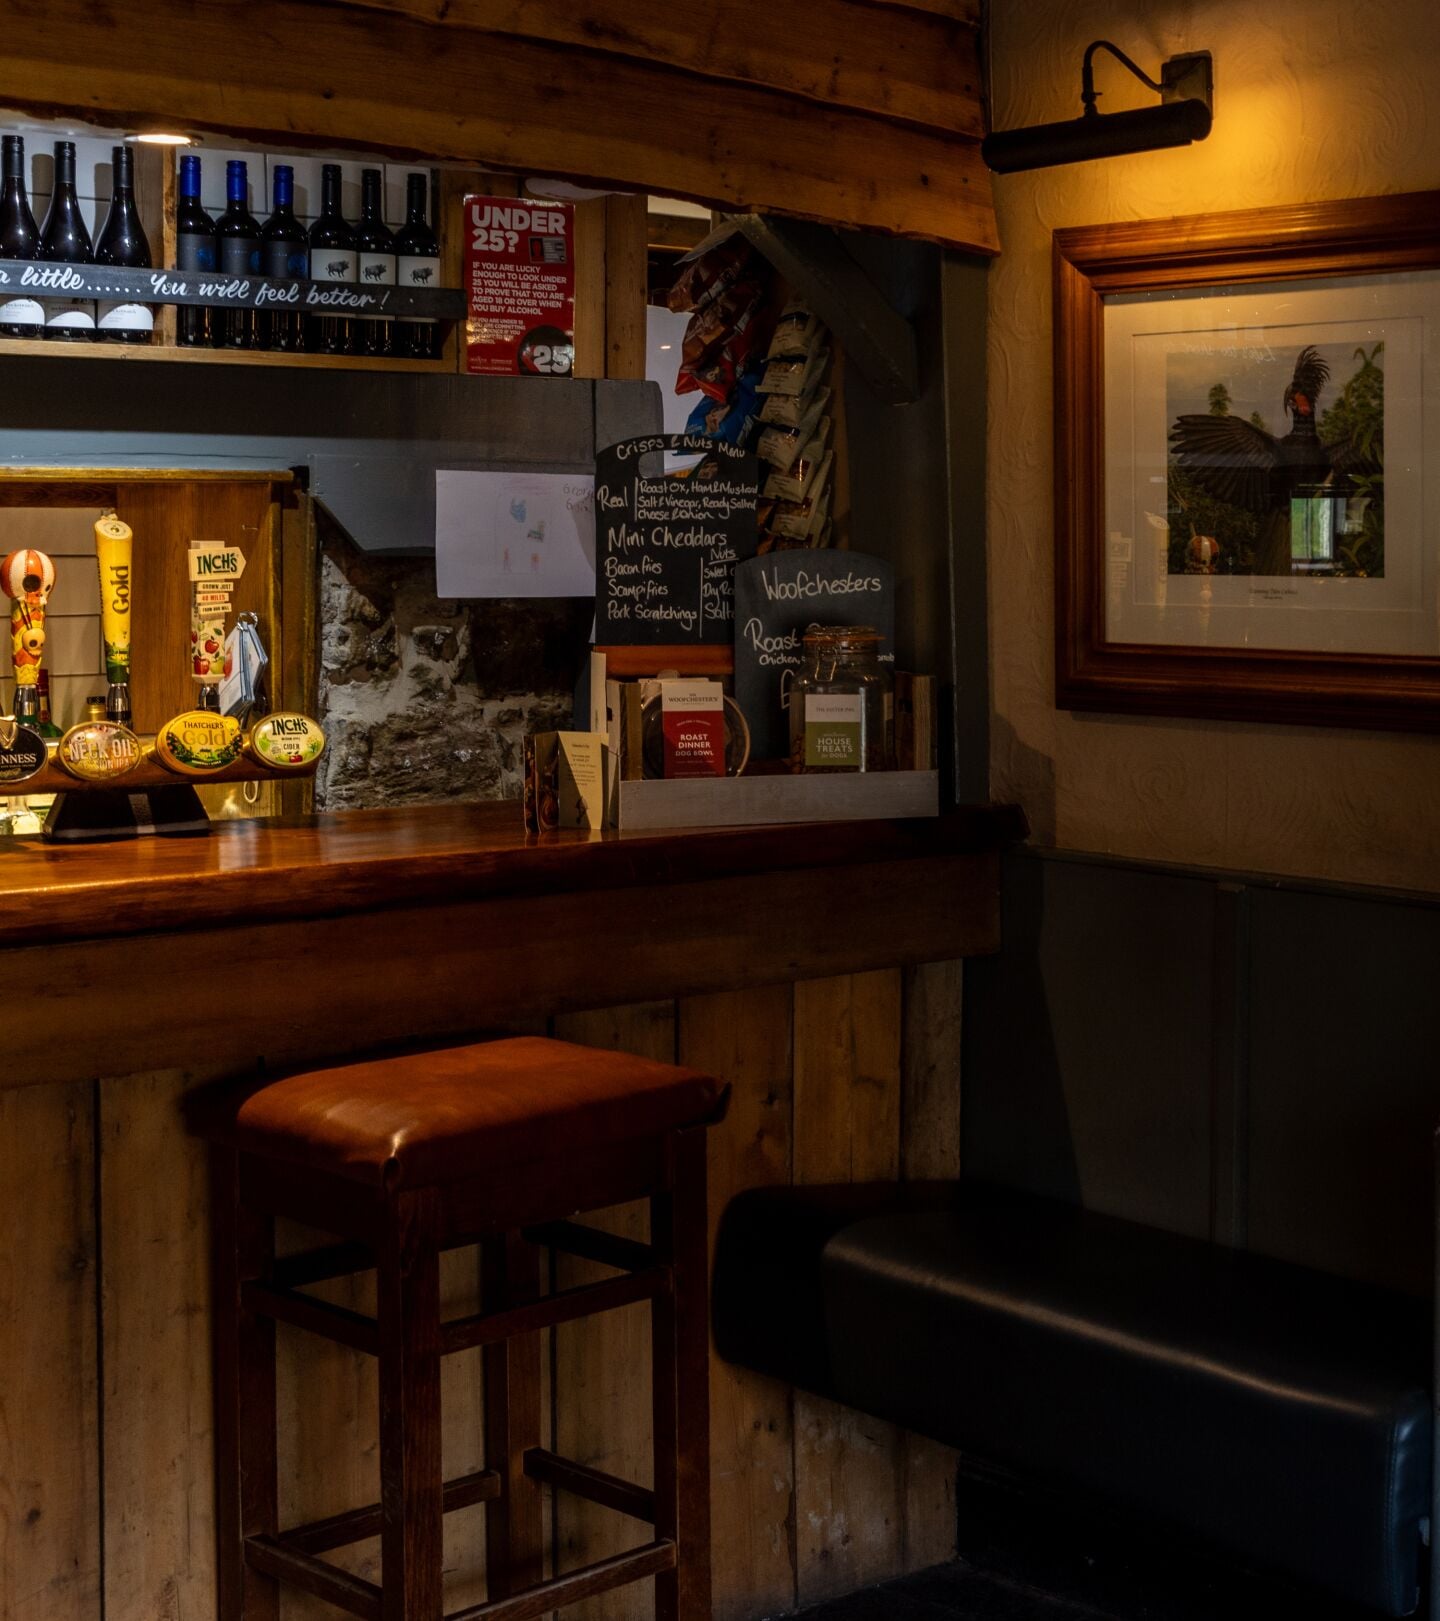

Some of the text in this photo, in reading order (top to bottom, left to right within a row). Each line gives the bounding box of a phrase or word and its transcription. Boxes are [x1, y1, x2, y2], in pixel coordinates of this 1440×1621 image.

[472, 204, 566, 235] UNDER
[472, 228, 520, 254] 25?
[472, 261, 541, 274] IF YOU ARE LUCKY
[472, 269, 567, 284] ENOUGH TO LOOK UNDER
[0, 270, 11, 284] a
[150, 273, 189, 296] You
[199, 278, 250, 299] will
[254, 282, 300, 306] feel
[472, 278, 558, 292] 25 YOU WILL BE ASKED
[472, 287, 565, 300] TO PROVE THAT YOU ARE
[472, 295, 494, 304] AGED
[503, 297, 516, 306] OR
[516, 298, 538, 307] OVER
[538, 300, 563, 309] WHEN
[472, 303, 544, 316] YOU BUY ALCOHOL
[533, 344, 573, 374] 25
[616, 437, 665, 460] Crisps
[683, 435, 713, 450] Nuts
[718, 442, 746, 459] Menu
[639, 479, 668, 495] Roast
[597, 484, 629, 512] Real
[637, 494, 658, 508] Salt
[607, 523, 728, 556] Mini Cheddars
[710, 547, 737, 561] Nuts
[196, 552, 238, 575] INCH'S
[604, 555, 663, 578] Bacon fries
[109, 564, 130, 615] Gold
[608, 578, 646, 602] Scampi
[761, 565, 882, 601] Woofchesters
[607, 600, 698, 632] Pork Scratchings
[743, 617, 802, 653] Roast
[183, 720, 225, 729] THATCHERS
[271, 718, 309, 736] INCH'S
[182, 729, 228, 747] Gold
[678, 741, 711, 749] DINNER
[680, 733, 708, 741] ROAST
[817, 737, 852, 746] HOUSE
[68, 738, 135, 762] NECK OIL
[816, 745, 854, 753] TREATS
